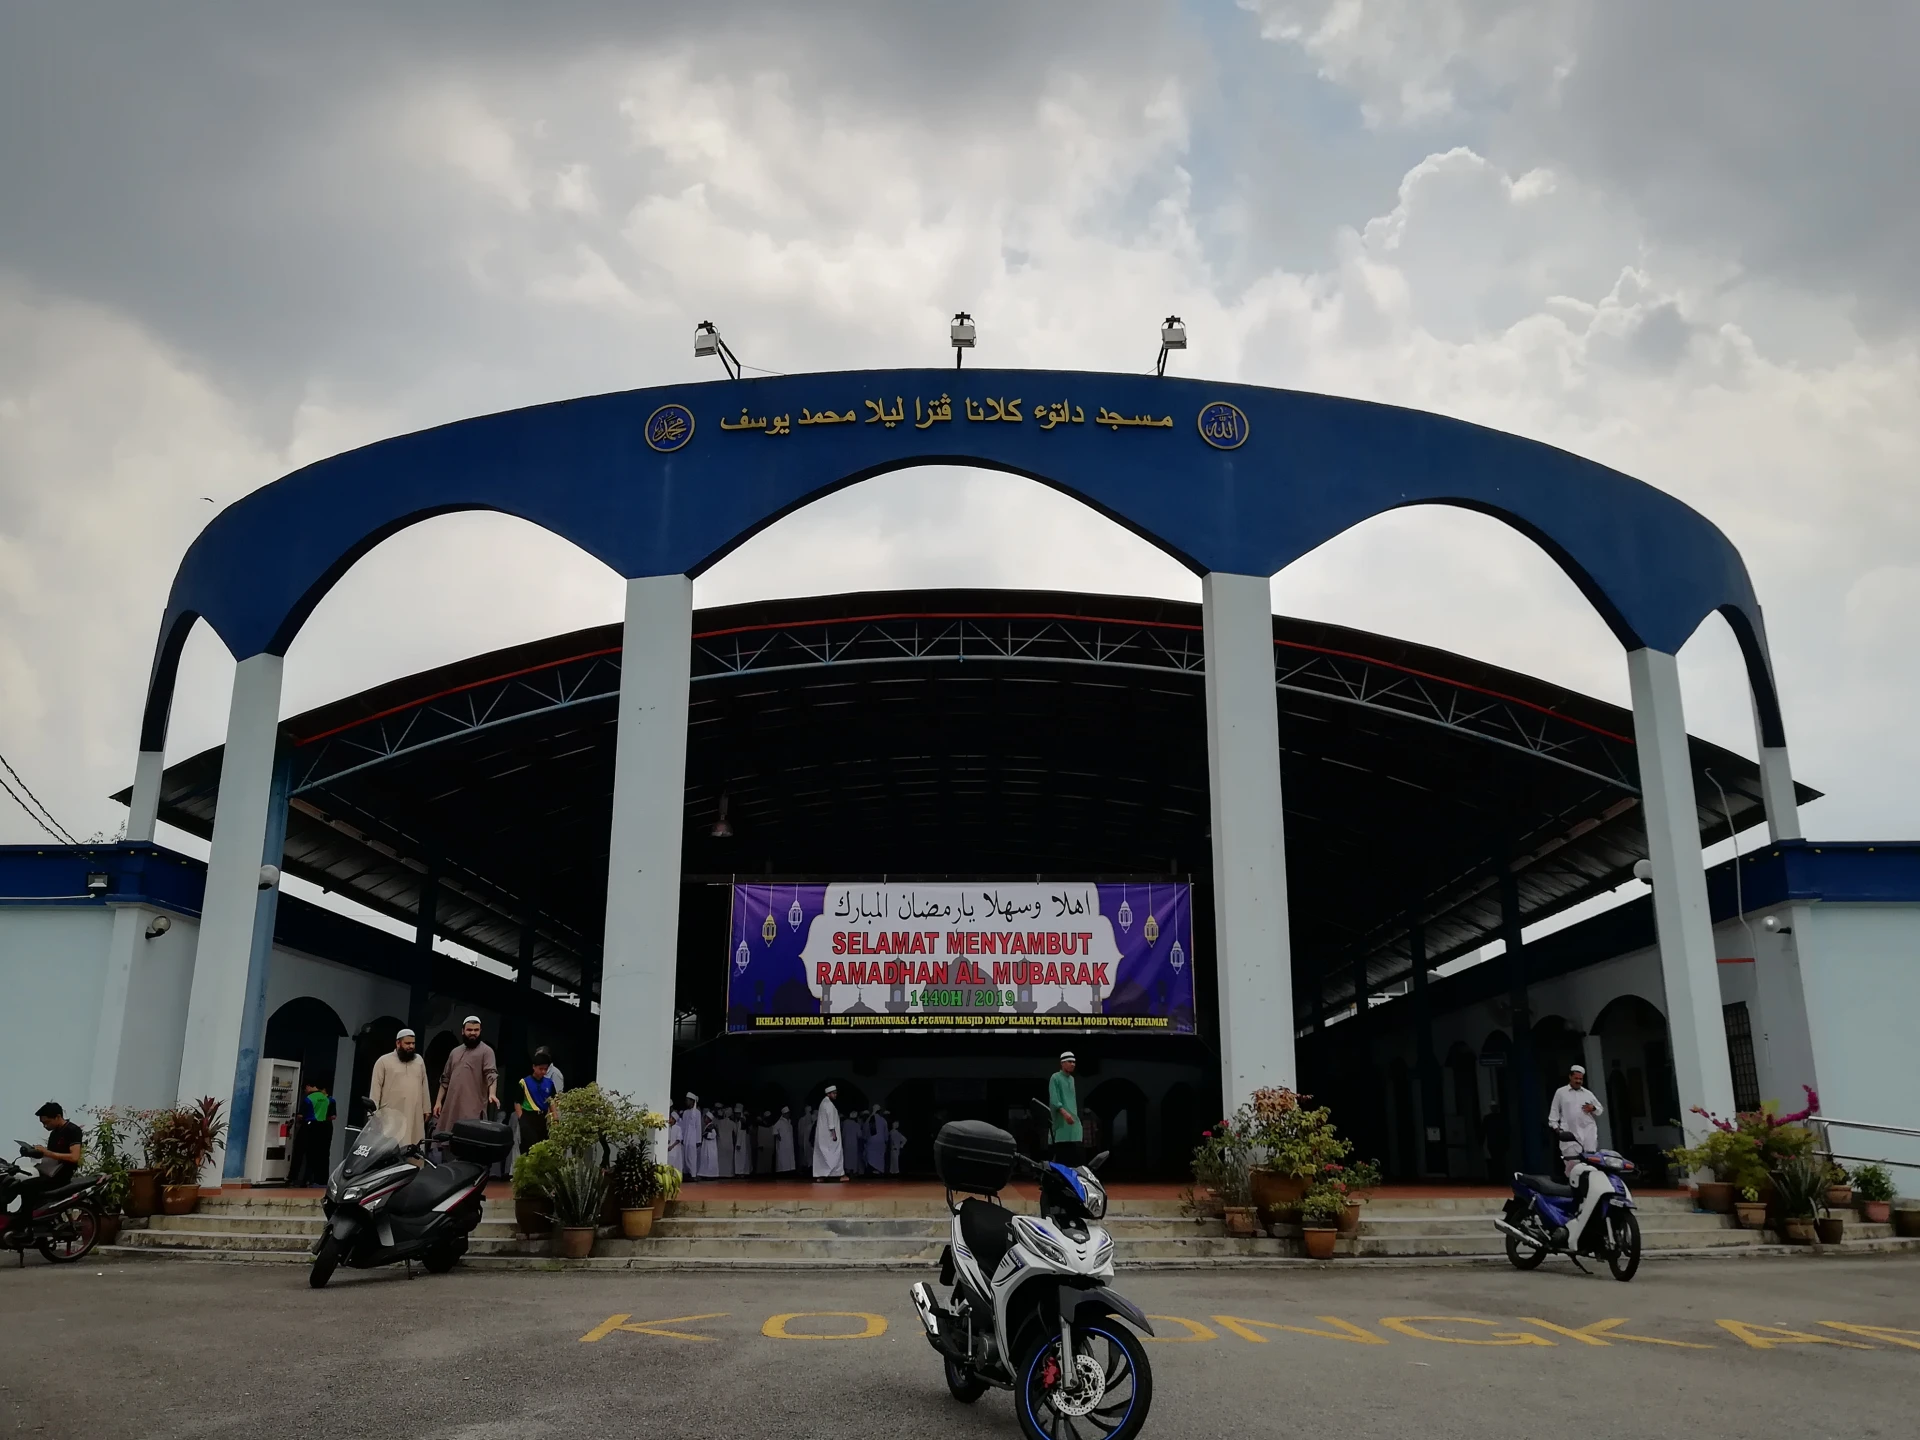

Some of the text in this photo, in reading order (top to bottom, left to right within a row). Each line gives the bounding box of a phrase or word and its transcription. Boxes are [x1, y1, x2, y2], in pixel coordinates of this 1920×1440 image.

[720, 407, 790, 435] يوسف
[797, 407, 857, 425] محمد
[864, 396, 905, 428] ليلا
[965, 396, 1023, 422] كلانا
[1095, 406, 1174, 431] مسجد
[834, 890, 888, 925] المبارك
[982, 890, 1042, 922] وسهلا
[1051, 890, 1091, 917] اهلا
[832, 931, 1093, 956] SELAMAT MENYAMBUT
[816, 961, 1110, 986] RAMADHAN AL MUBARAK
[910, 989, 963, 1007] 1440H
[974, 989, 1015, 1007] 2019
[755, 1016, 784, 1026] IKHLAS
[785, 1016, 825, 1026] DARIPADA
[850, 1016, 910, 1027] JAWATANKUASA
[910, 1017, 917, 1025] &
[917, 1016, 954, 1025] PEGAWAI
[955, 1016, 983, 1027] MASJID
[1008, 1016, 1035, 1025] KLANA
[1035, 1016, 1062, 1026] PETRA
[1062, 1016, 1082, 1026] LELA
[1083, 1016, 1108, 1026] MOHD
[1133, 1017, 1169, 1027] SIKAMAT
